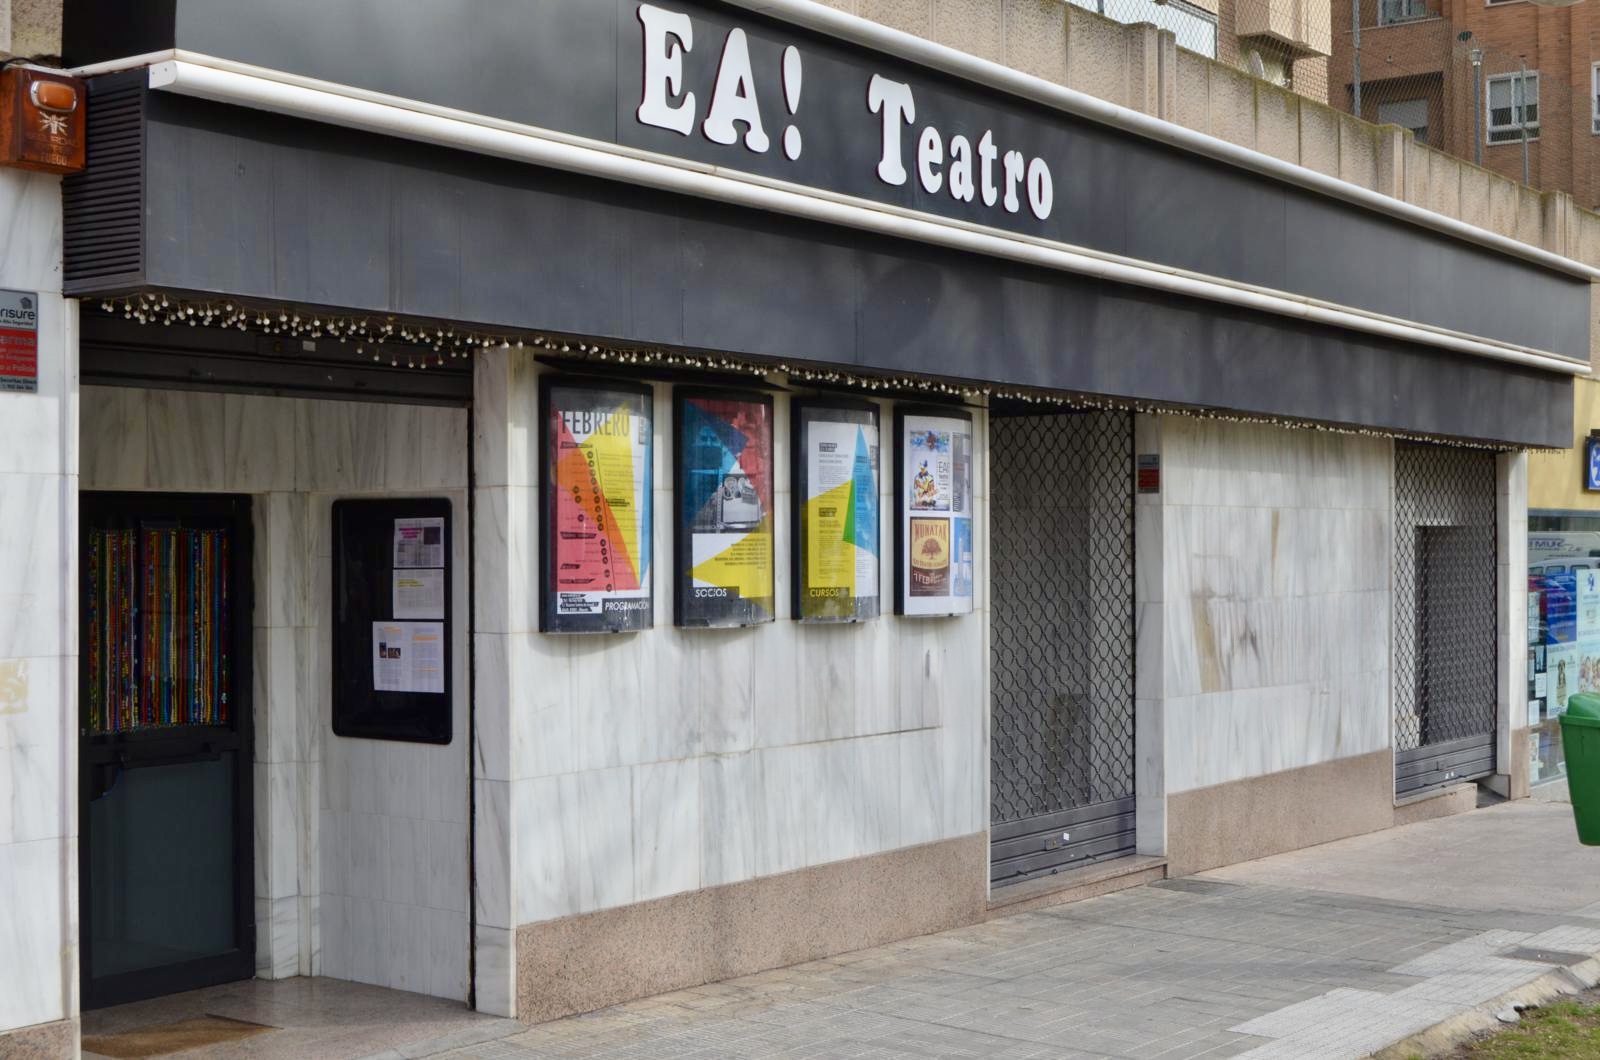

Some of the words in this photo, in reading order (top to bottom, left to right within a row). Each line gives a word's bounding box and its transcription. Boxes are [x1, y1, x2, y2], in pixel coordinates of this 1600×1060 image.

[636, 3, 802, 161] EA!
[868, 73, 1053, 221] Teatro
[561, 410, 630, 437] FEBRERO
[695, 588, 727, 598] SOCIOS
[809, 588, 840, 598] CURSOS
